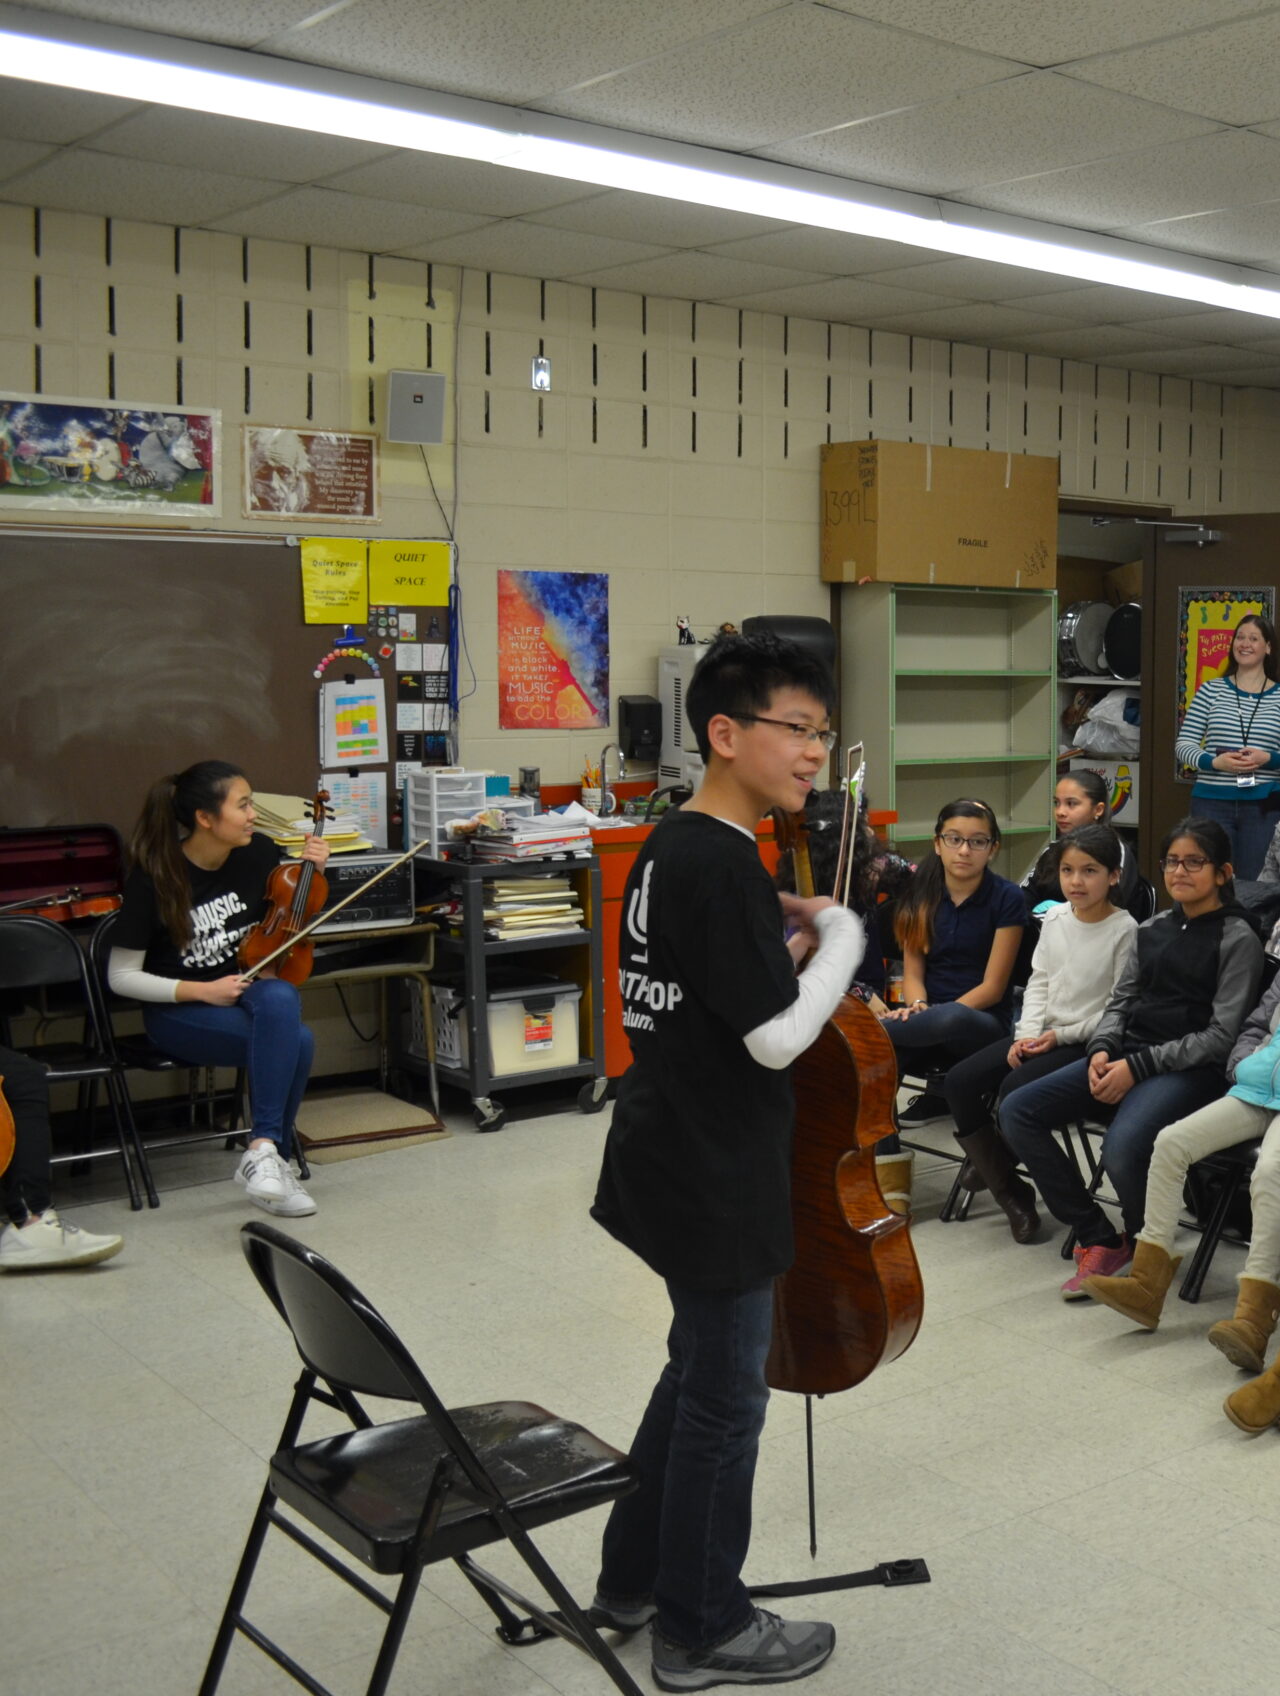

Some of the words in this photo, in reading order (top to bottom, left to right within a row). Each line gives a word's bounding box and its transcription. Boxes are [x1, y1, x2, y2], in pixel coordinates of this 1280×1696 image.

[958, 537, 989, 548] FRAGILE
[394, 552, 427, 563] QUIET
[312, 559, 333, 568] Quiet
[335, 560, 358, 568] Space
[394, 576, 427, 586] SPACE
[513, 626, 541, 635] LIFE
[511, 641, 546, 650] MUSIC
[508, 664, 528, 672] and
[508, 682, 554, 694] MUSIC
[190, 892, 247, 930] MUSIC.
